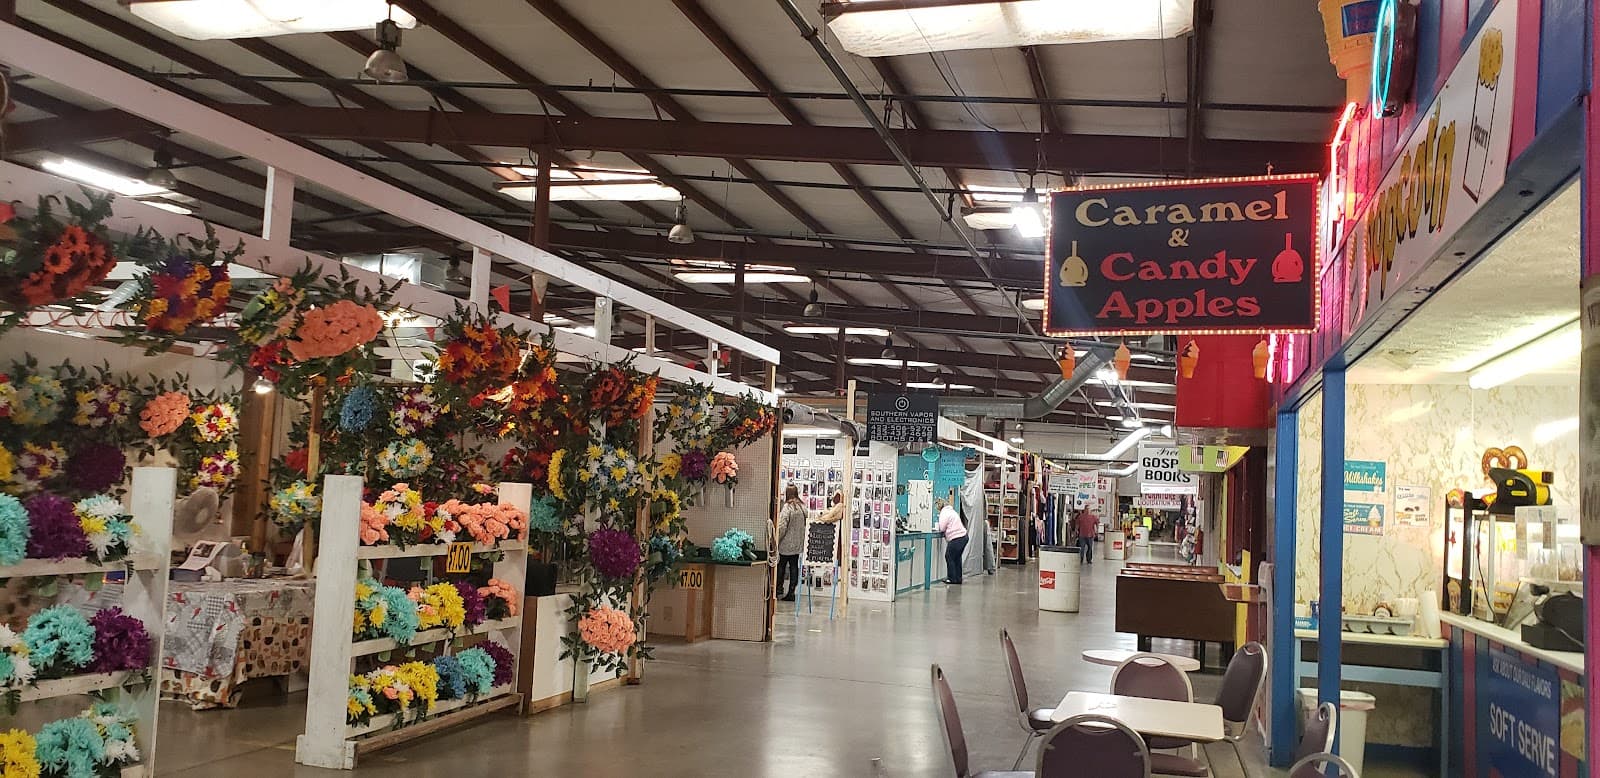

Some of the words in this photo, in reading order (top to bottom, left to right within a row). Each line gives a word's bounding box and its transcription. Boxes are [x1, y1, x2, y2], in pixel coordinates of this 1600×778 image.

[1075, 190, 1289, 227] Caramel
[1167, 228, 1190, 248] &
[1100, 250, 1257, 286] Candy
[1096, 289, 1261, 325] Apples
[887, 416, 935, 424] ELECTRONICS
[1142, 457, 1179, 469] GOSP
[1144, 470, 1191, 483] BOOKS
[1344, 470, 1383, 485] Milkshakes
[1489, 702, 1516, 748] SOFT
[1518, 719, 1556, 776] SERVE
